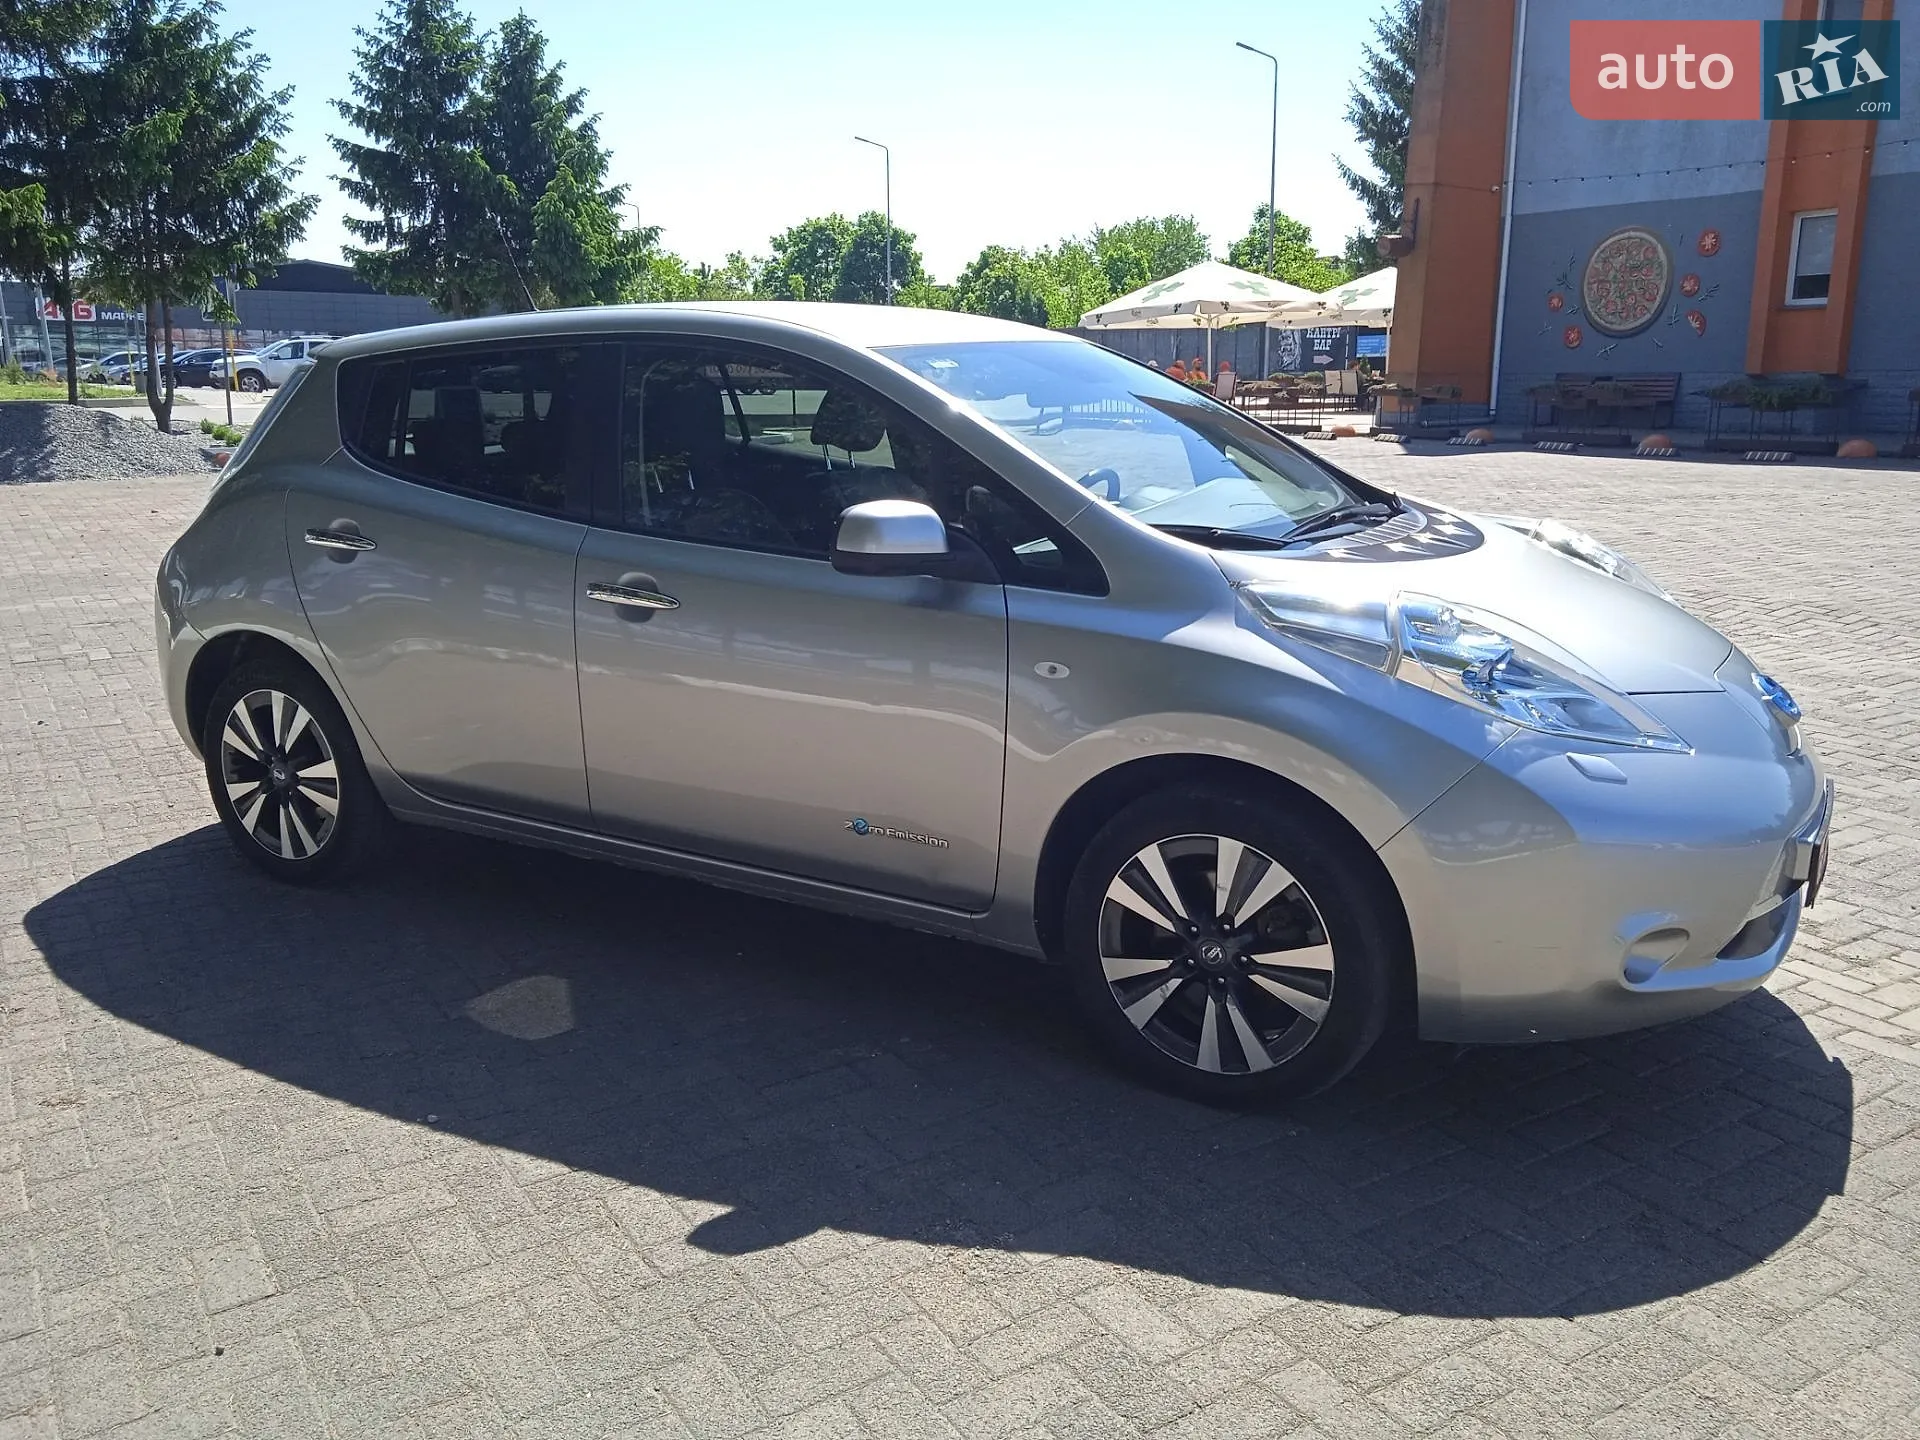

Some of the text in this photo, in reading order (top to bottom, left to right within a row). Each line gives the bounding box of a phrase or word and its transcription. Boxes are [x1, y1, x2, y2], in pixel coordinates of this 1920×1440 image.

[38, 300, 93, 320] АБ
[1313, 339, 1332, 350] БАР
[886, 829, 949, 848] Emission
